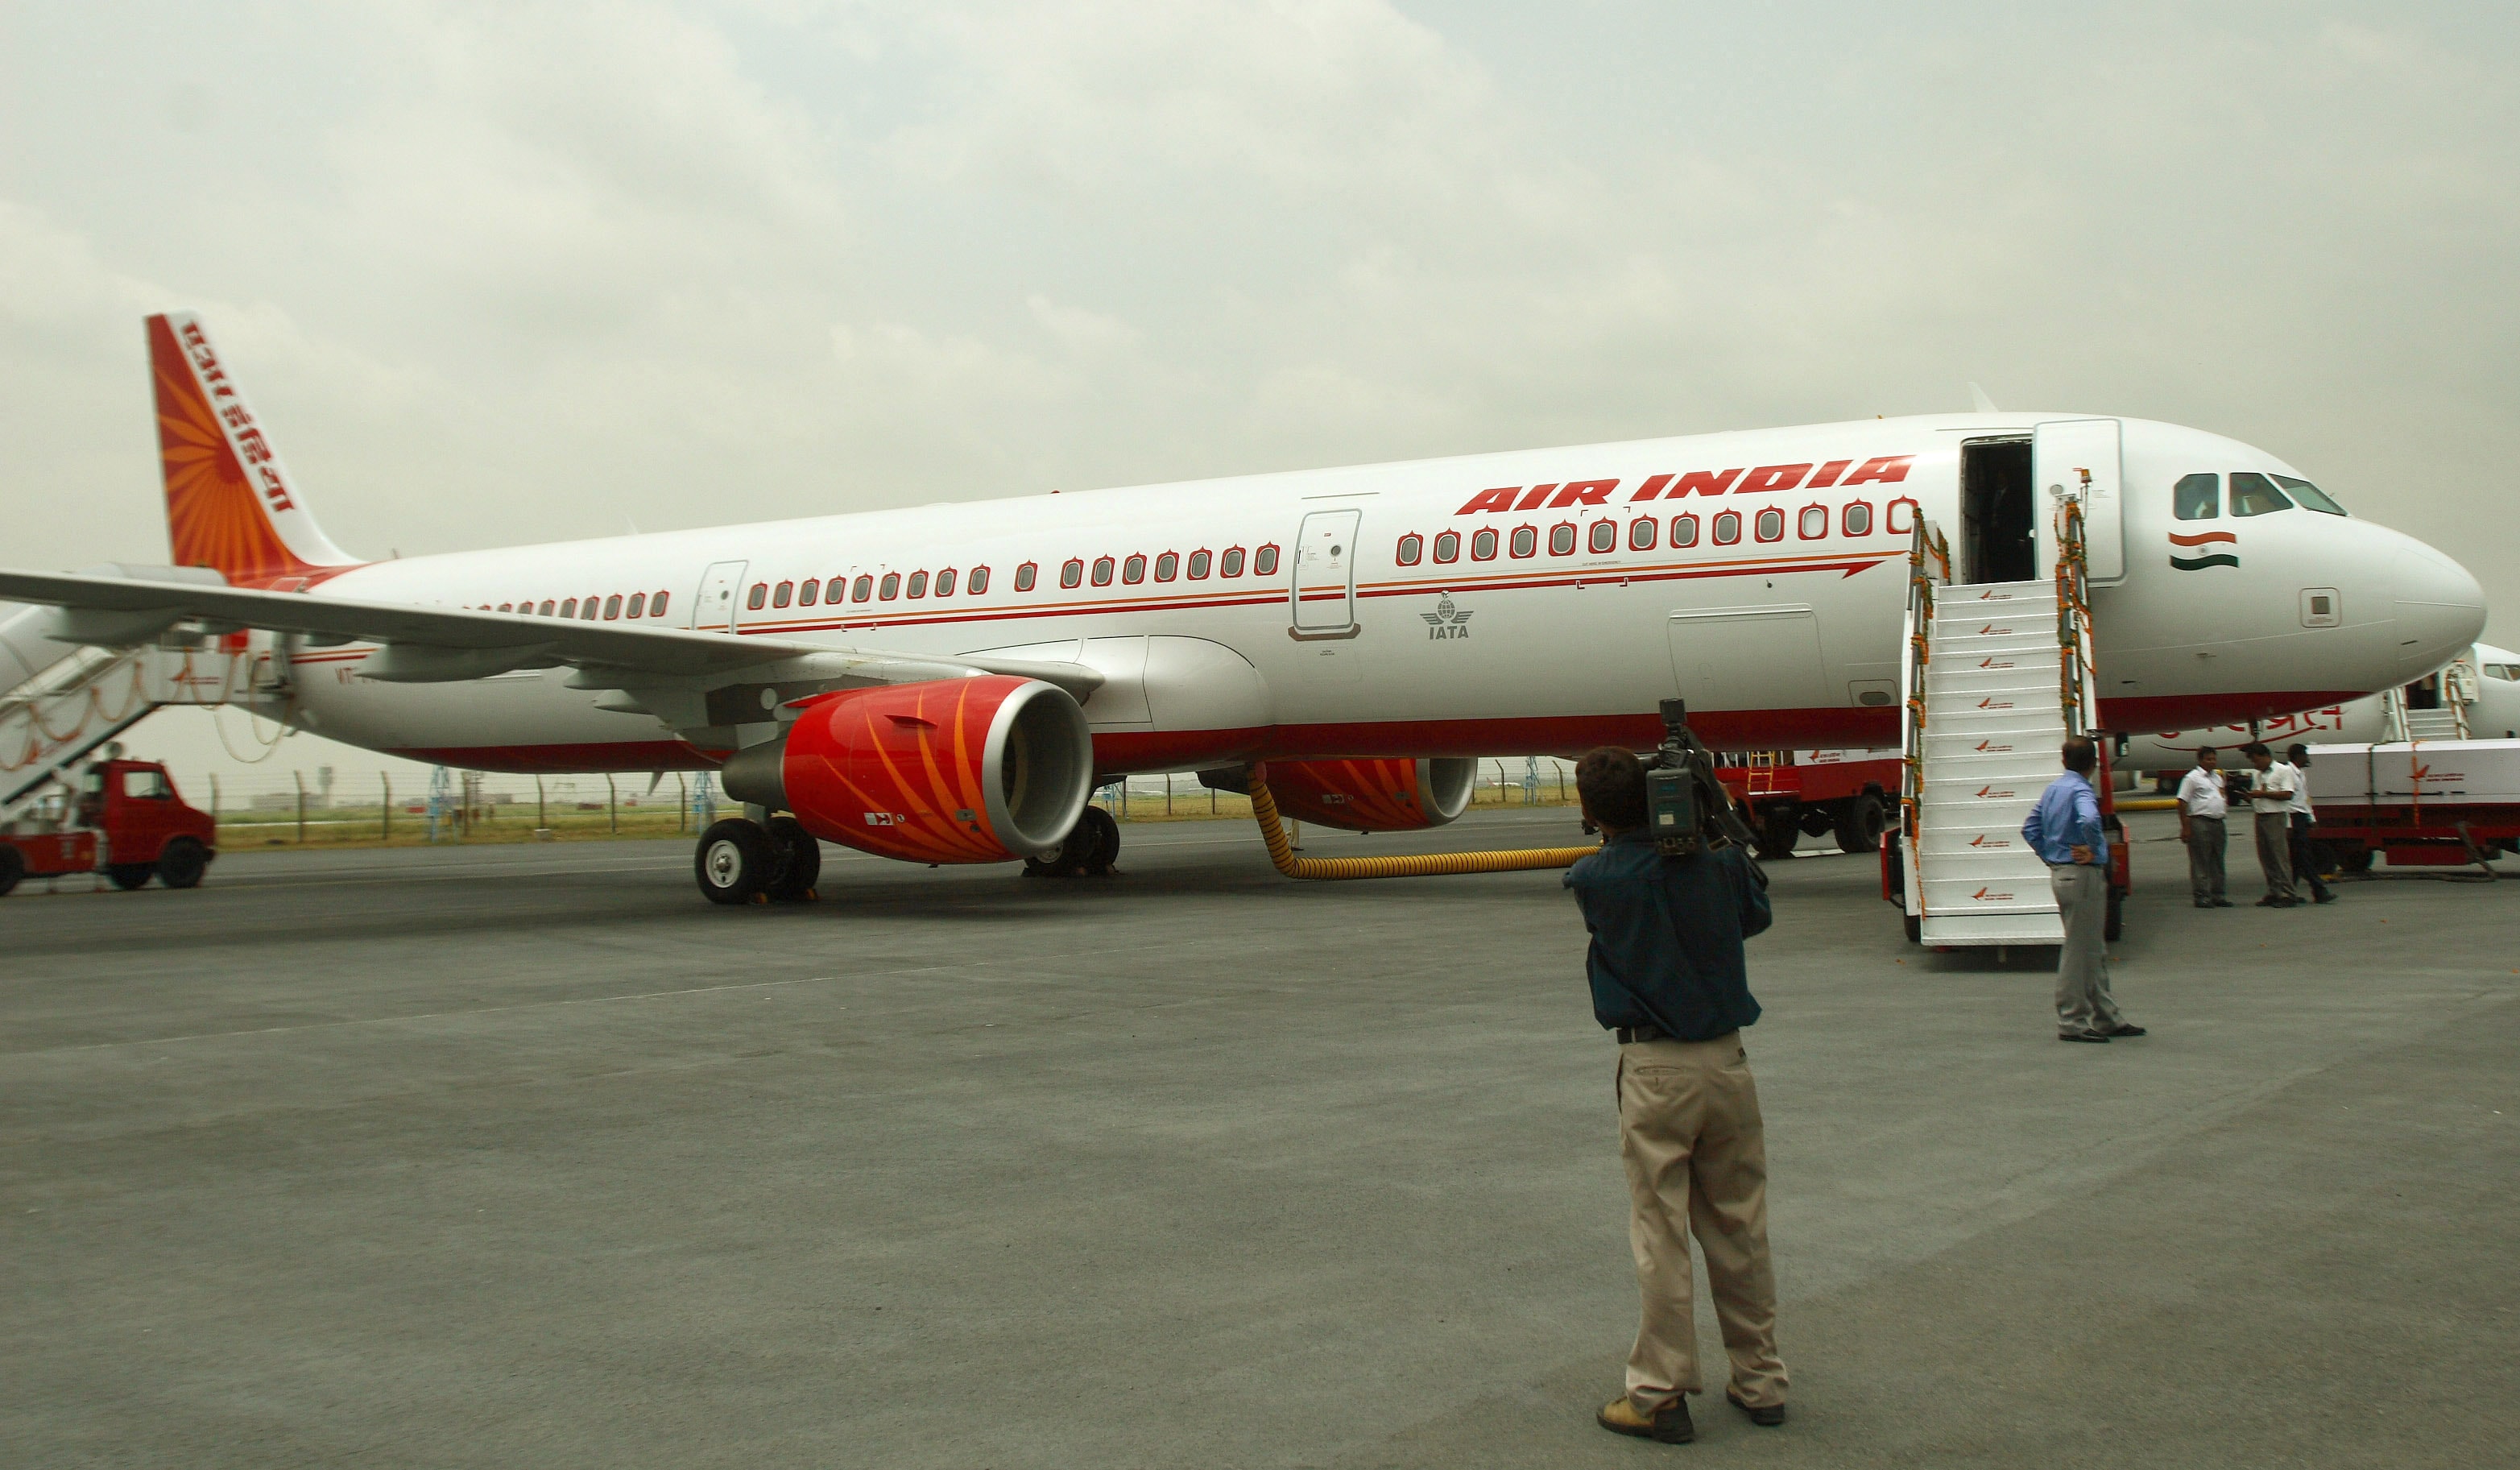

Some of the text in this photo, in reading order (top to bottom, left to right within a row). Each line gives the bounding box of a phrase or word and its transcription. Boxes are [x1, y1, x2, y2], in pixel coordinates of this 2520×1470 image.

[1454, 454, 1917, 516] AIR INDIA
[1430, 625, 1469, 640] IATA
